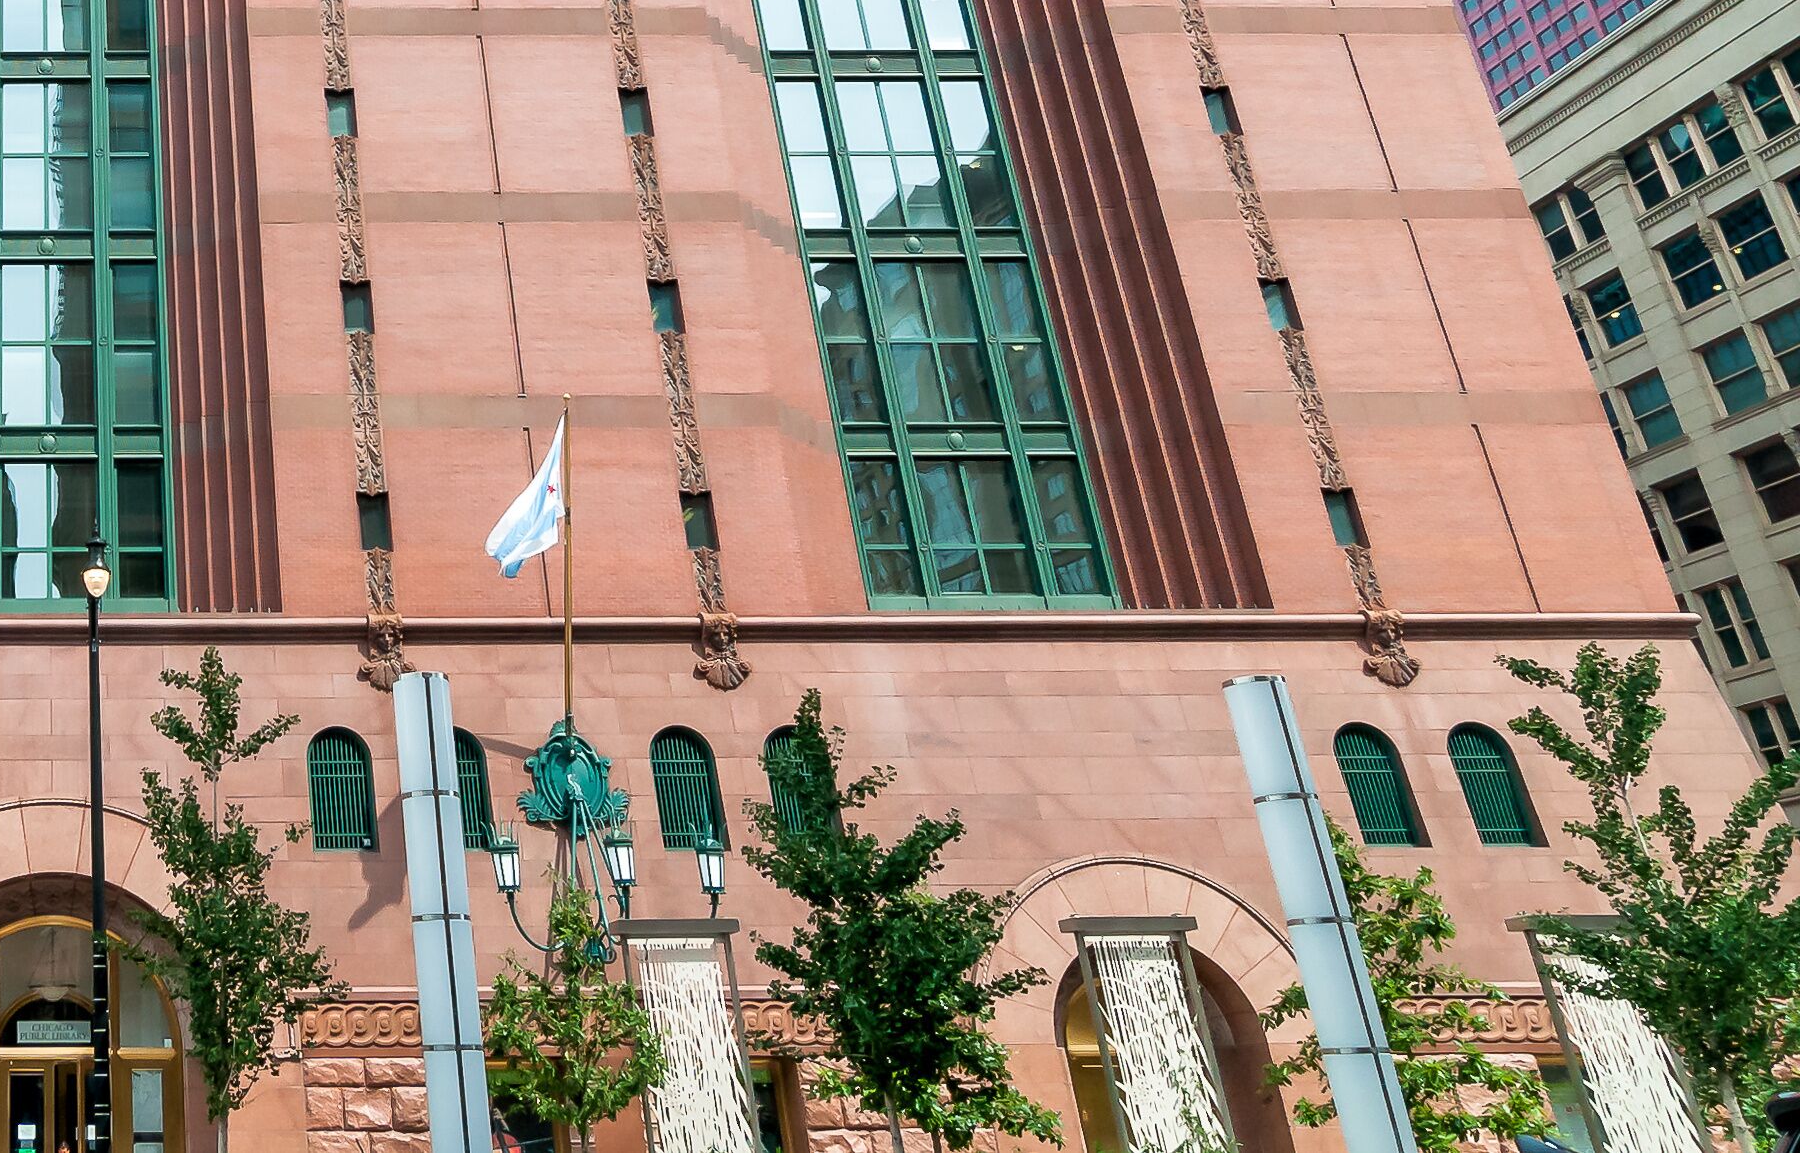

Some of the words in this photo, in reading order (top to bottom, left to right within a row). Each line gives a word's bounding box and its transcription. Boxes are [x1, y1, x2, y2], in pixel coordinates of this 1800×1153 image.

[32, 1023, 73, 1031] CHICAGO
[20, 1032, 50, 1040] PUBLIC
[52, 1032, 87, 1040] LIBRARY
